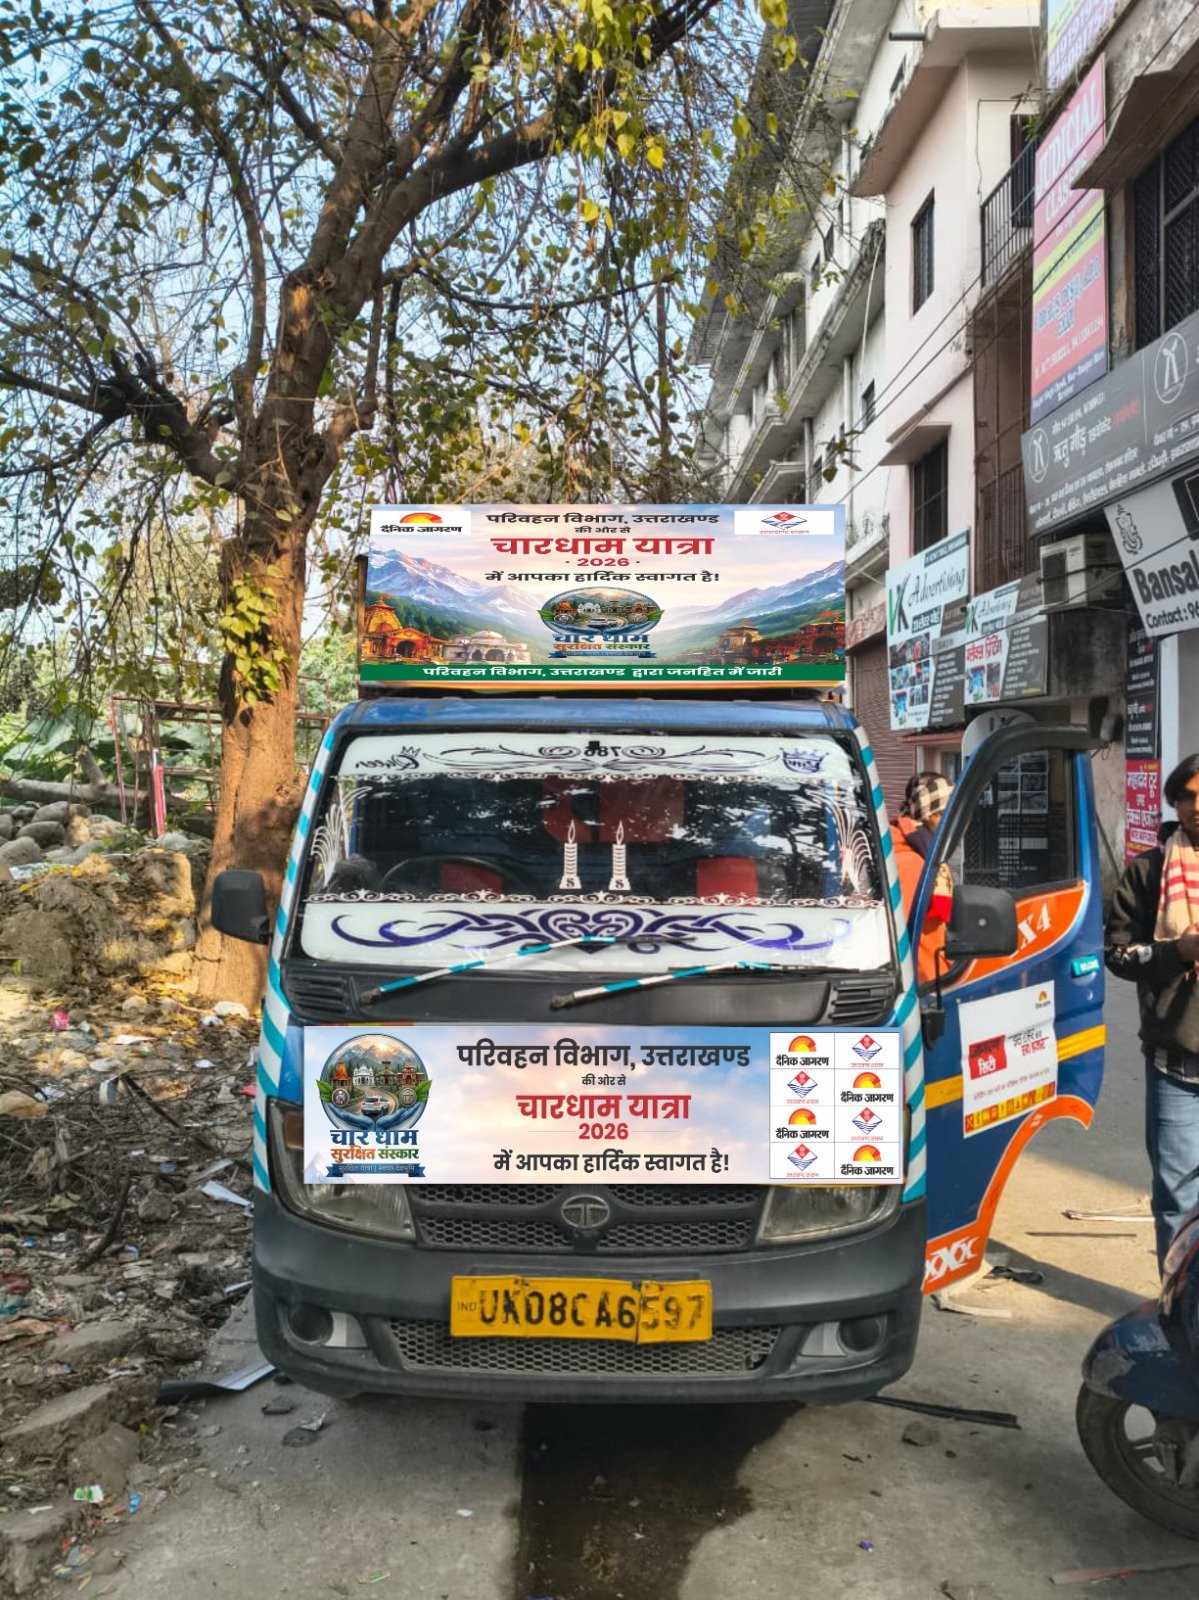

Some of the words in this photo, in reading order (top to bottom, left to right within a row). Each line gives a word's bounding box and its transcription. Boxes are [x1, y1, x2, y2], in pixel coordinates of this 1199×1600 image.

[485, 513, 559, 524] परिवहन
[563, 513, 628, 525] विभाग,
[632, 514, 719, 524] उत्तराखण्ड
[380, 525, 414, 533] दैनिक
[490, 538, 626, 554] चारधाम
[633, 538, 715, 554] यात्रा
[577, 558, 630, 567] 2026
[485, 570, 504, 581] में
[508, 573, 571, 582] आपका
[574, 570, 630, 582] हार्दिक
[635, 573, 696, 582] स्वागत
[701, 570, 719, 582] है!
[1133, 549, 1199, 604] Bansal
[908, 567, 966, 607] Advertising
[422, 666, 486, 676] परिवहन
[490, 666, 546, 677] विभाग,
[549, 668, 625, 676] उत्तराखण्ड
[632, 668, 664, 678] द्वारा
[667, 666, 725, 677] जनहित
[728, 666, 745, 676] में
[747, 667, 783, 676] जारी
[457, 1037, 550, 1069] परिवहन
[554, 1037, 636, 1071] विभाग,
[641, 1045, 752, 1067] उत्तराखण्ड
[775, 1054, 798, 1066] दैनिक
[799, 1056, 829, 1066] जागरण
[582, 1073, 595, 1086] की
[598, 1075, 616, 1086] ओर
[617, 1073, 626, 1086] से
[840, 1091, 863, 1103] दैनिक
[864, 1093, 894, 1103] जागरण
[516, 1095, 622, 1119] चारधाम
[627, 1095, 691, 1119] यात्रा
[578, 1122, 629, 1140] 2026
[775, 1127, 798, 1139] दैनिक
[799, 1130, 829, 1139] जागरण
[329, 1130, 369, 1145] चार
[375, 1130, 419, 1145] धाम
[331, 1145, 376, 1163] सुरक्षित
[378, 1146, 419, 1160] संस्कार
[493, 1148, 513, 1171] में
[516, 1153, 579, 1171] आपका
[583, 1148, 640, 1173] हार्दिक
[644, 1153, 706, 1171] स्वागत
[710, 1147, 729, 1173] है!
[840, 1164, 863, 1175] दैनिक
[864, 1166, 894, 1175] जागरण
[457, 1302, 477, 1312] IND
